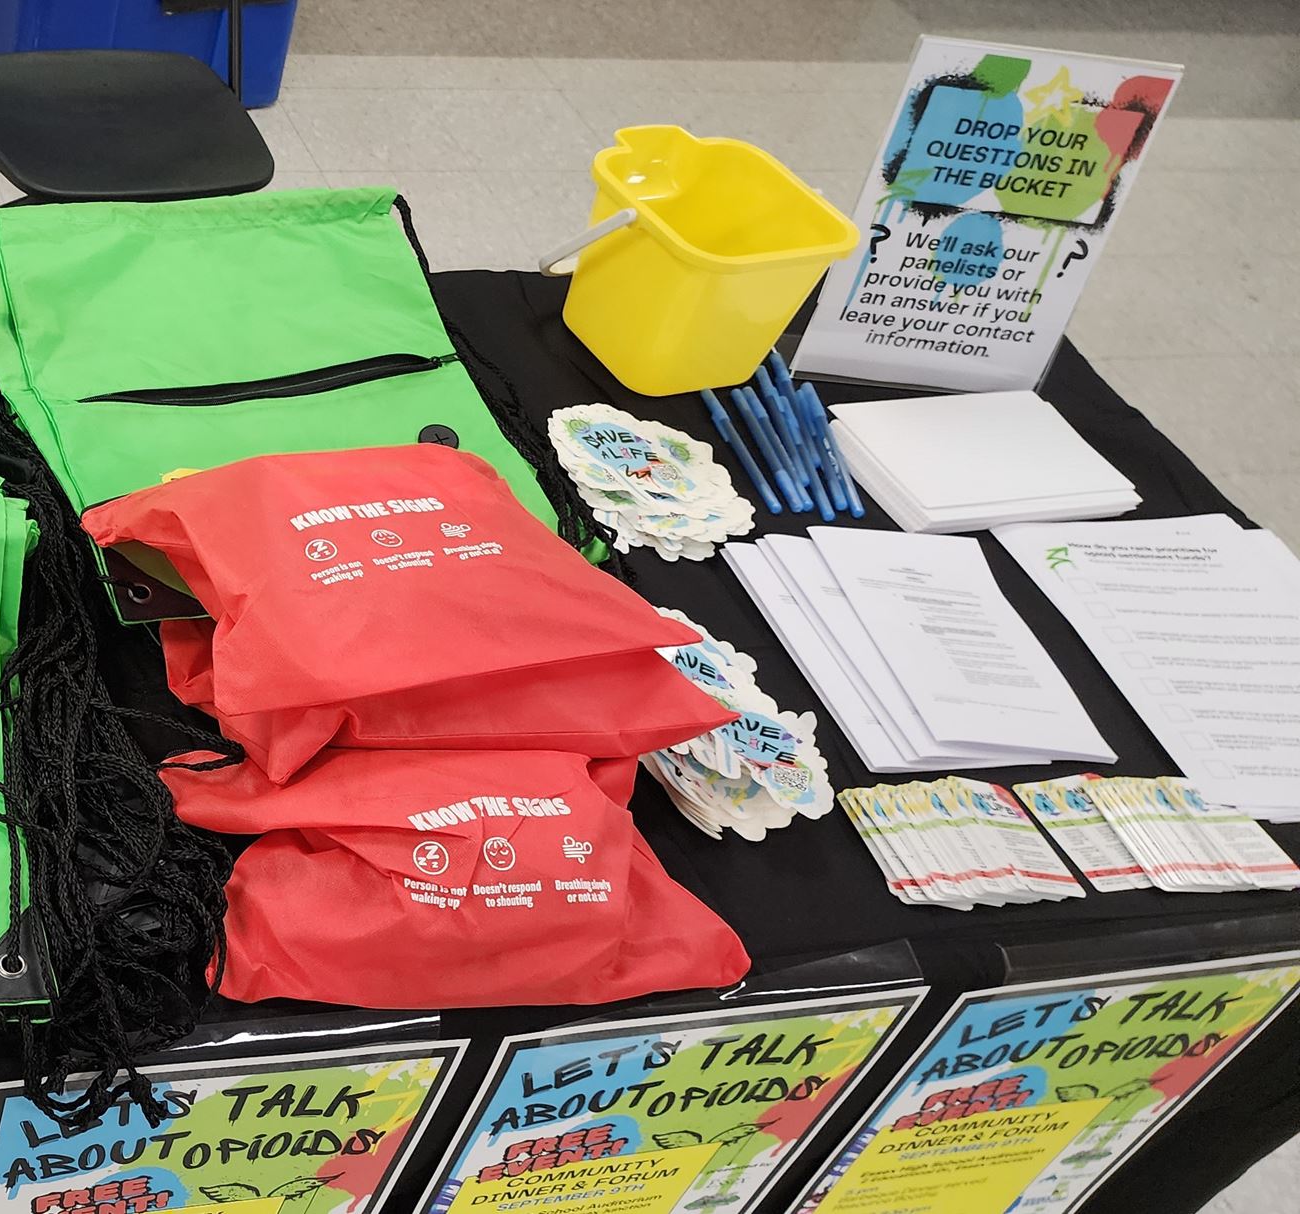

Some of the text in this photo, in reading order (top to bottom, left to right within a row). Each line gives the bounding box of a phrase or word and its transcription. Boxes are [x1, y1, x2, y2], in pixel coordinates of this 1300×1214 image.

[954, 118, 1088, 151] DROP YOUR
[926, 140, 1097, 177] QUESTIONS IN
[931, 166, 1072, 199] THE BUCKET
[905, 231, 1040, 264] We'll ask our
[899, 252, 1026, 281] panelists or
[864, 271, 1042, 304] provide you with
[860, 291, 1031, 324] an answer if you
[839, 306, 1035, 343] leave your contact
[865, 329, 990, 358] information.
[582, 429, 635, 449] SAVE
[601, 452, 609, 460] A
[289, 497, 445, 531] KNOW THE SIGNS
[310, 565, 341, 580] Person
[347, 560, 363, 569] not
[387, 563, 398, 571] to
[674, 649, 716, 679] AVE
[731, 718, 781, 740] AVE
[407, 796, 572, 831] KNOW THE SIGNS
[403, 877, 438, 892] Person
[450, 886, 467, 897] not
[410, 891, 460, 910] waking up
[472, 879, 542, 895] Doesn't respond
[485, 894, 534, 908] to shouting
[554, 878, 593, 892] Breathing
[567, 893, 577, 903] or
[578, 892, 592, 902] not
[957, 990, 1243, 1048] LET'S TALK
[522, 1033, 835, 1097] LET'S TALK
[918, 1031, 1228, 1086] ABOUT OPIOIDS
[221, 1083, 376, 1125] TALK
[489, 1074, 832, 1137] ABOUT OPIOIDS
[920, 1074, 1028, 1110] FREE
[890, 1089, 1035, 1132] EVENT!
[914, 1111, 1059, 1138] COMMUNITY
[503, 1123, 616, 1162] FREE
[878, 1133, 966, 1154] DINNER
[969, 1130, 985, 1141] &
[989, 1121, 1070, 1139] FORUM
[899, 1141, 999, 1161] SEPTEMBER
[2, 1128, 388, 1190] ABOUT OPIOIDS
[475, 1137, 629, 1184] EVENT!
[506, 1157, 665, 1188] COMMUNITY
[31, 1175, 154, 1214] FREE
[470, 1181, 566, 1206] DINNER
[570, 1178, 588, 1191] &
[593, 1167, 681, 1188] FORUM
[496, 1183, 646, 1212] SEPTEMBER 9TH
[585, 1195, 663, 1210] Auditorium
